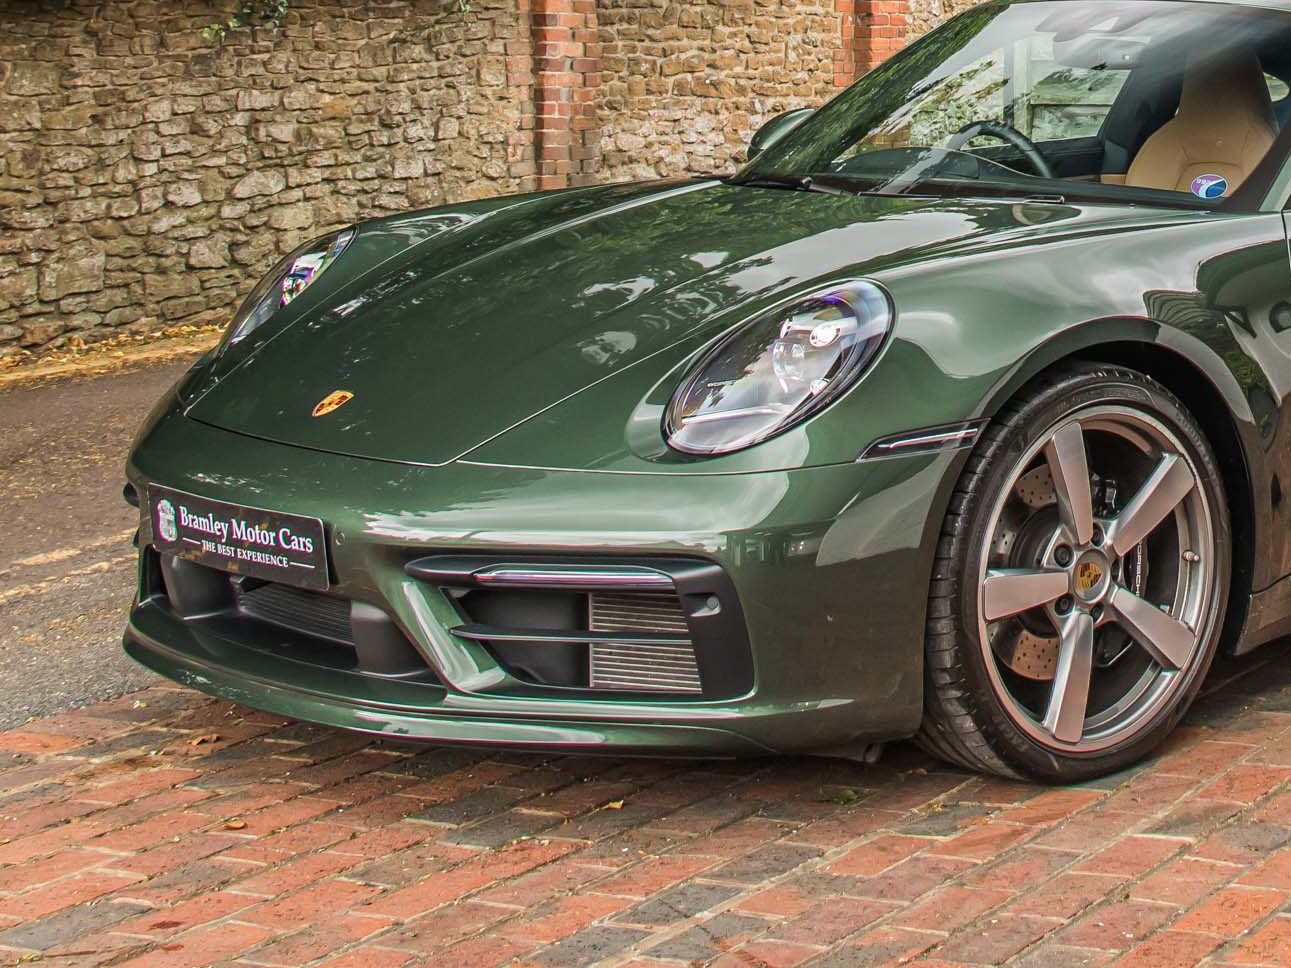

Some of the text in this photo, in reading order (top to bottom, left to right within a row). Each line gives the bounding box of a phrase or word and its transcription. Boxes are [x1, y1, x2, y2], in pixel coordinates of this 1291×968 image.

[178, 505, 314, 553] Bramley Motor Cars
[201, 540, 289, 568] THE BEST EXPERIENCE
